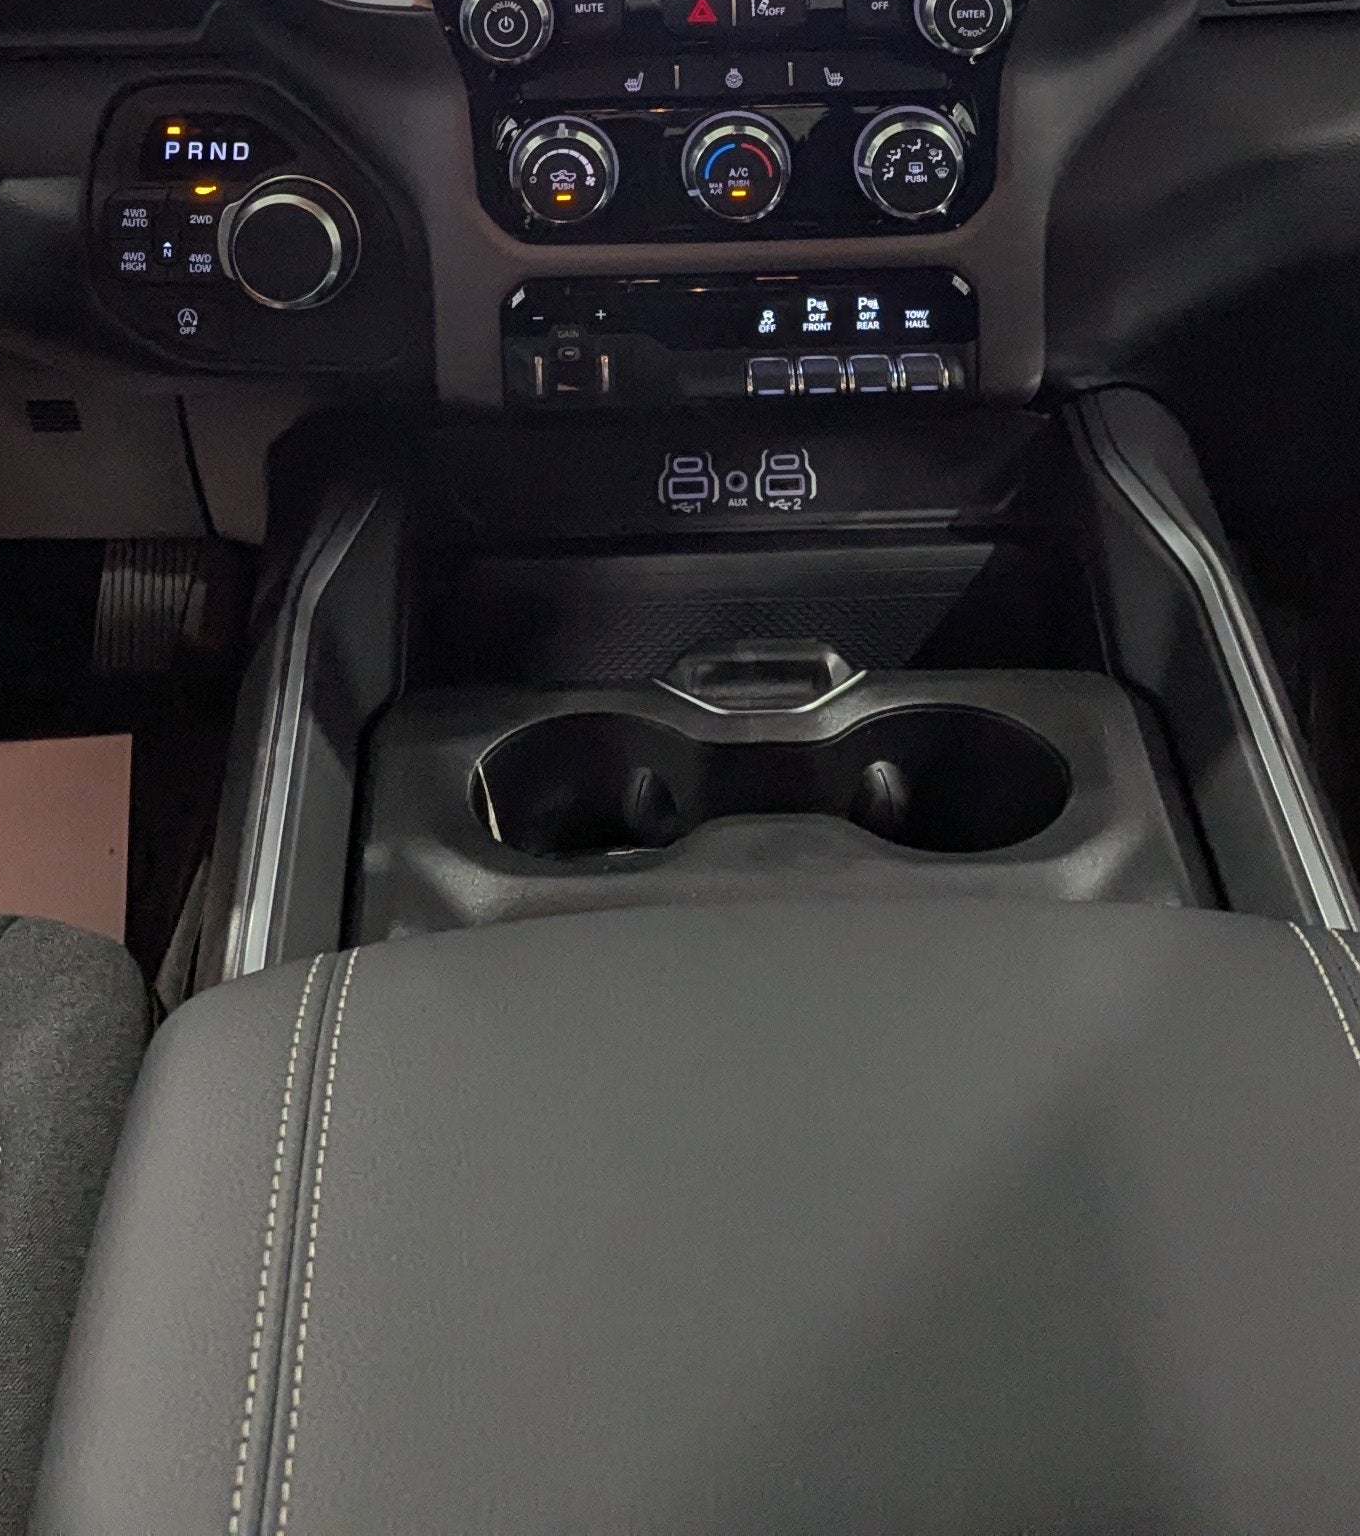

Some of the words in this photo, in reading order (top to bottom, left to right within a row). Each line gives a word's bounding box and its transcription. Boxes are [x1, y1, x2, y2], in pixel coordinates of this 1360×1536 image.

[491, 0, 522, 13] VOLUME
[574, 2, 604, 13] MUTE
[871, 1, 889, 10] OFF
[769, 7, 786, 16] OFF
[956, 10, 986, 19] ENTER
[957, 25, 987, 37] SCROLL
[729, 167, 749, 178] A/C
[728, 179, 750, 187] PUSH
[905, 175, 928, 183] PUSH
[552, 182, 575, 191] PUSH
[123, 209, 147, 218] 4WD
[121, 218, 148, 228] AUTO
[190, 215, 213, 224] 2WD
[122, 252, 146, 261] 4WD
[163, 249, 172, 258] N
[189, 254, 212, 263] 4WD
[121, 262, 146, 271] HIGH
[189, 264, 212, 273] LOW
[808, 313, 826, 322] OFF
[859, 312, 876, 321] OFF
[905, 310, 929, 319] TOW/
[803, 322, 832, 331] FRONT
[857, 321, 880, 330] REAR
[905, 319, 930, 328] HAUL
[180, 327, 197, 335] OFF
[758, 324, 776, 333] OFF
[557, 330, 579, 339] GAIN
[728, 498, 748, 507] AUX
[793, 498, 802, 510] 2
